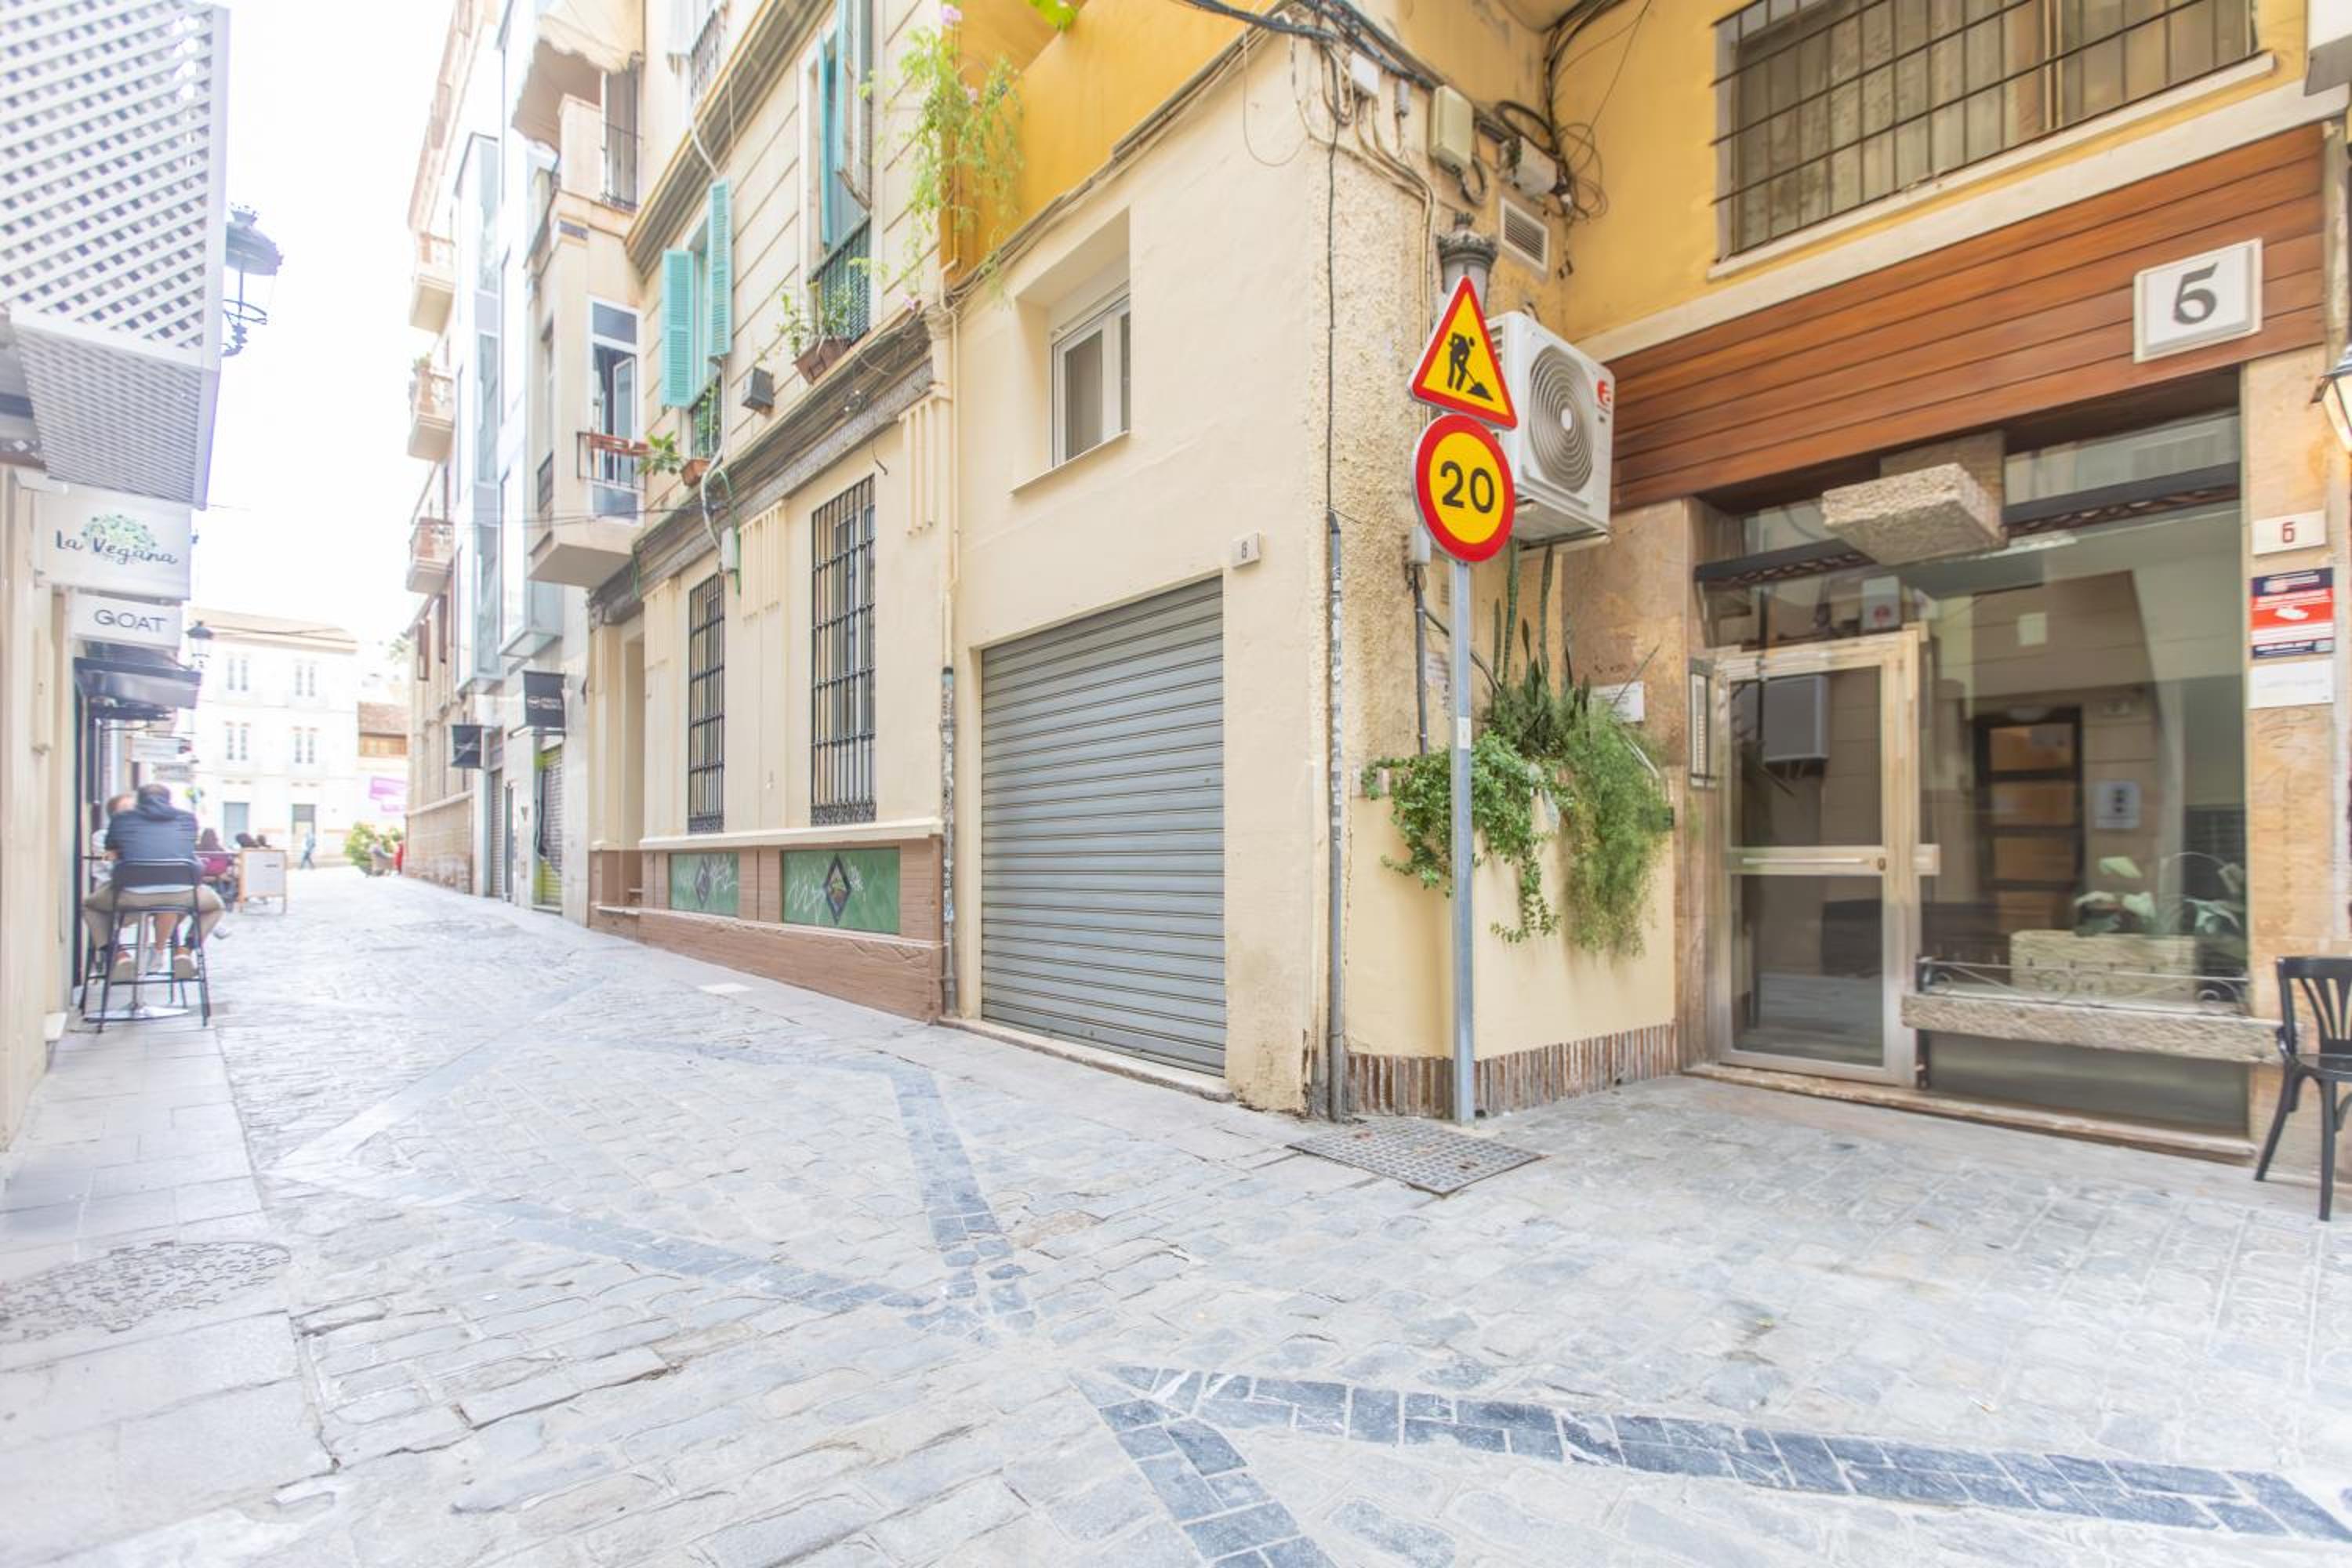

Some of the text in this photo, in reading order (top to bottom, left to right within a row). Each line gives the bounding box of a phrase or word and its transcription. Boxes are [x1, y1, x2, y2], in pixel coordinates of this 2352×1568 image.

[1439, 460, 1495, 514] 20
[93, 536, 179, 565] Vegana
[94, 608, 168, 633] GOAT
